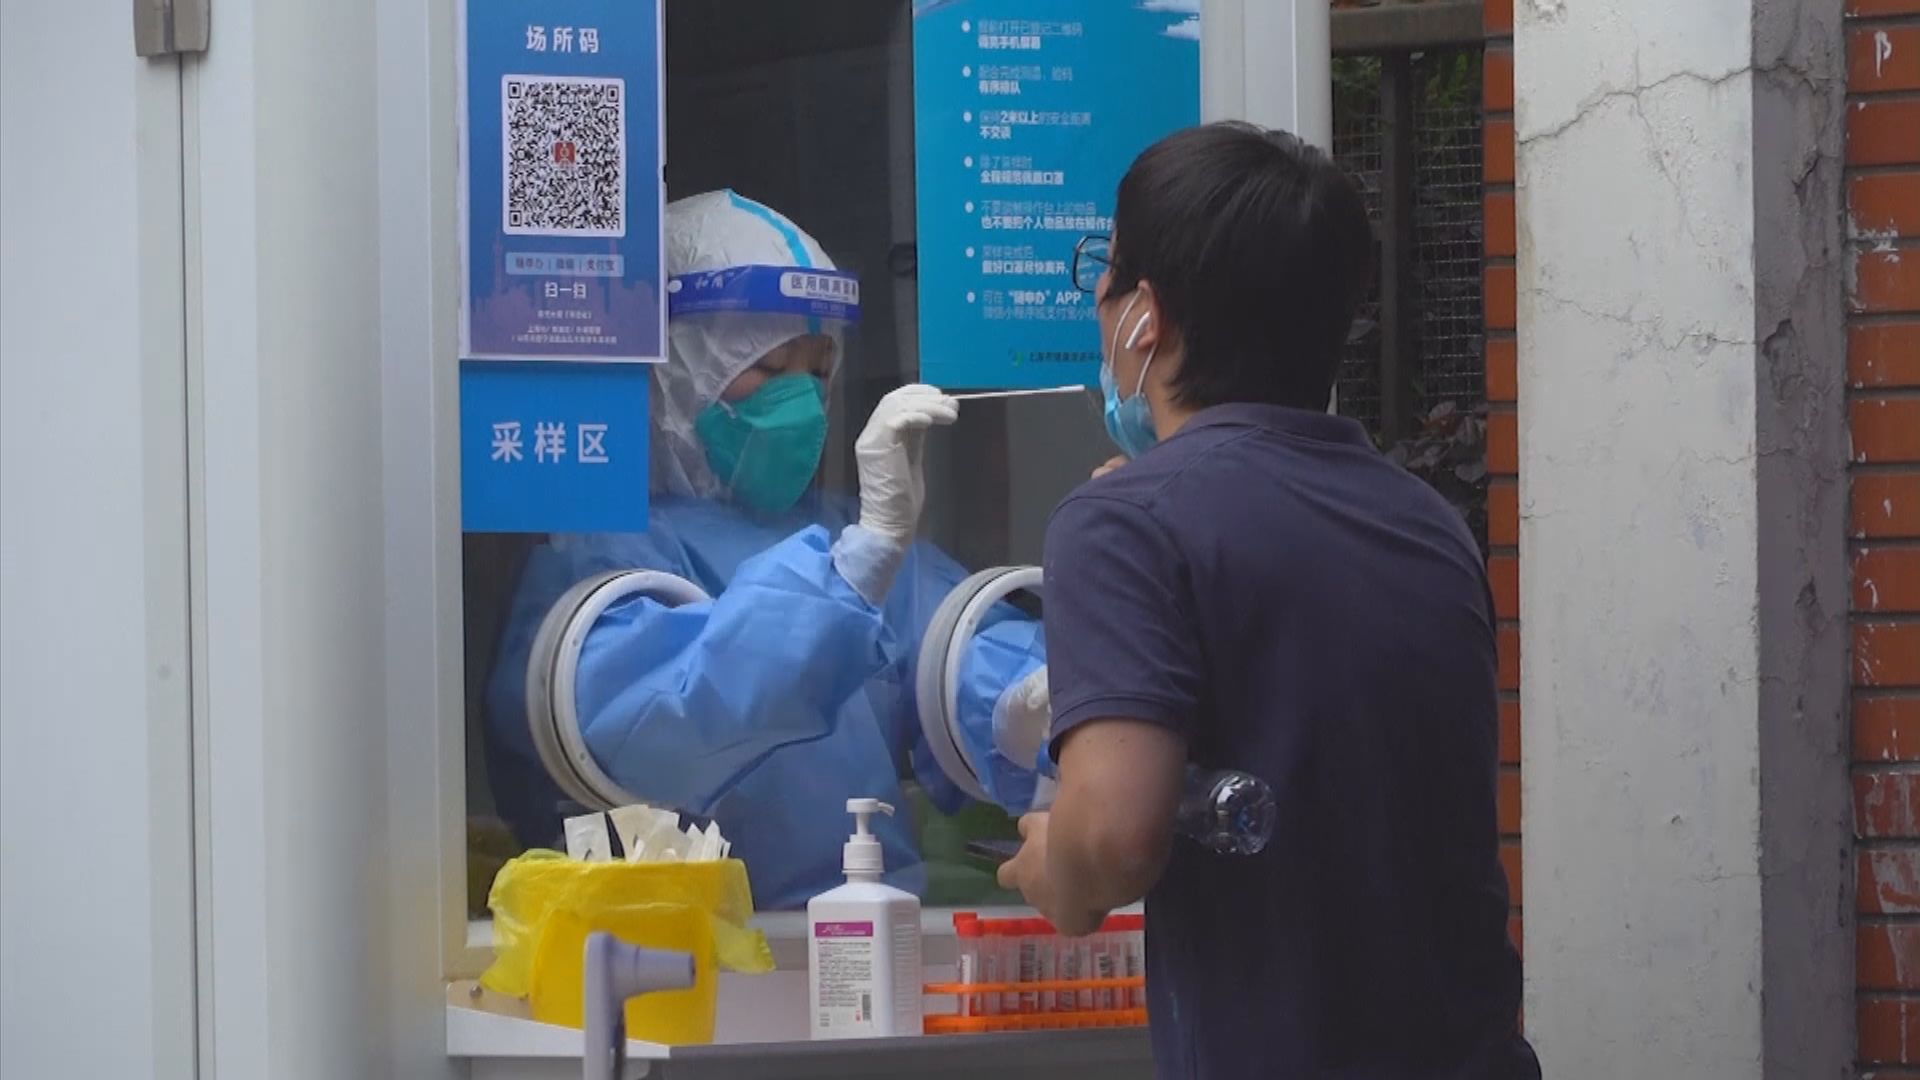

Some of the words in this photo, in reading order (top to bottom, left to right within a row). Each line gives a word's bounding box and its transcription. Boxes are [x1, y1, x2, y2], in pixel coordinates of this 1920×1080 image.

[526, 25, 600, 53] 场所码
[586, 259, 616, 272] 支付宝
[544, 281, 586, 299] 扫一扫
[490, 421, 610, 464] 采样区
